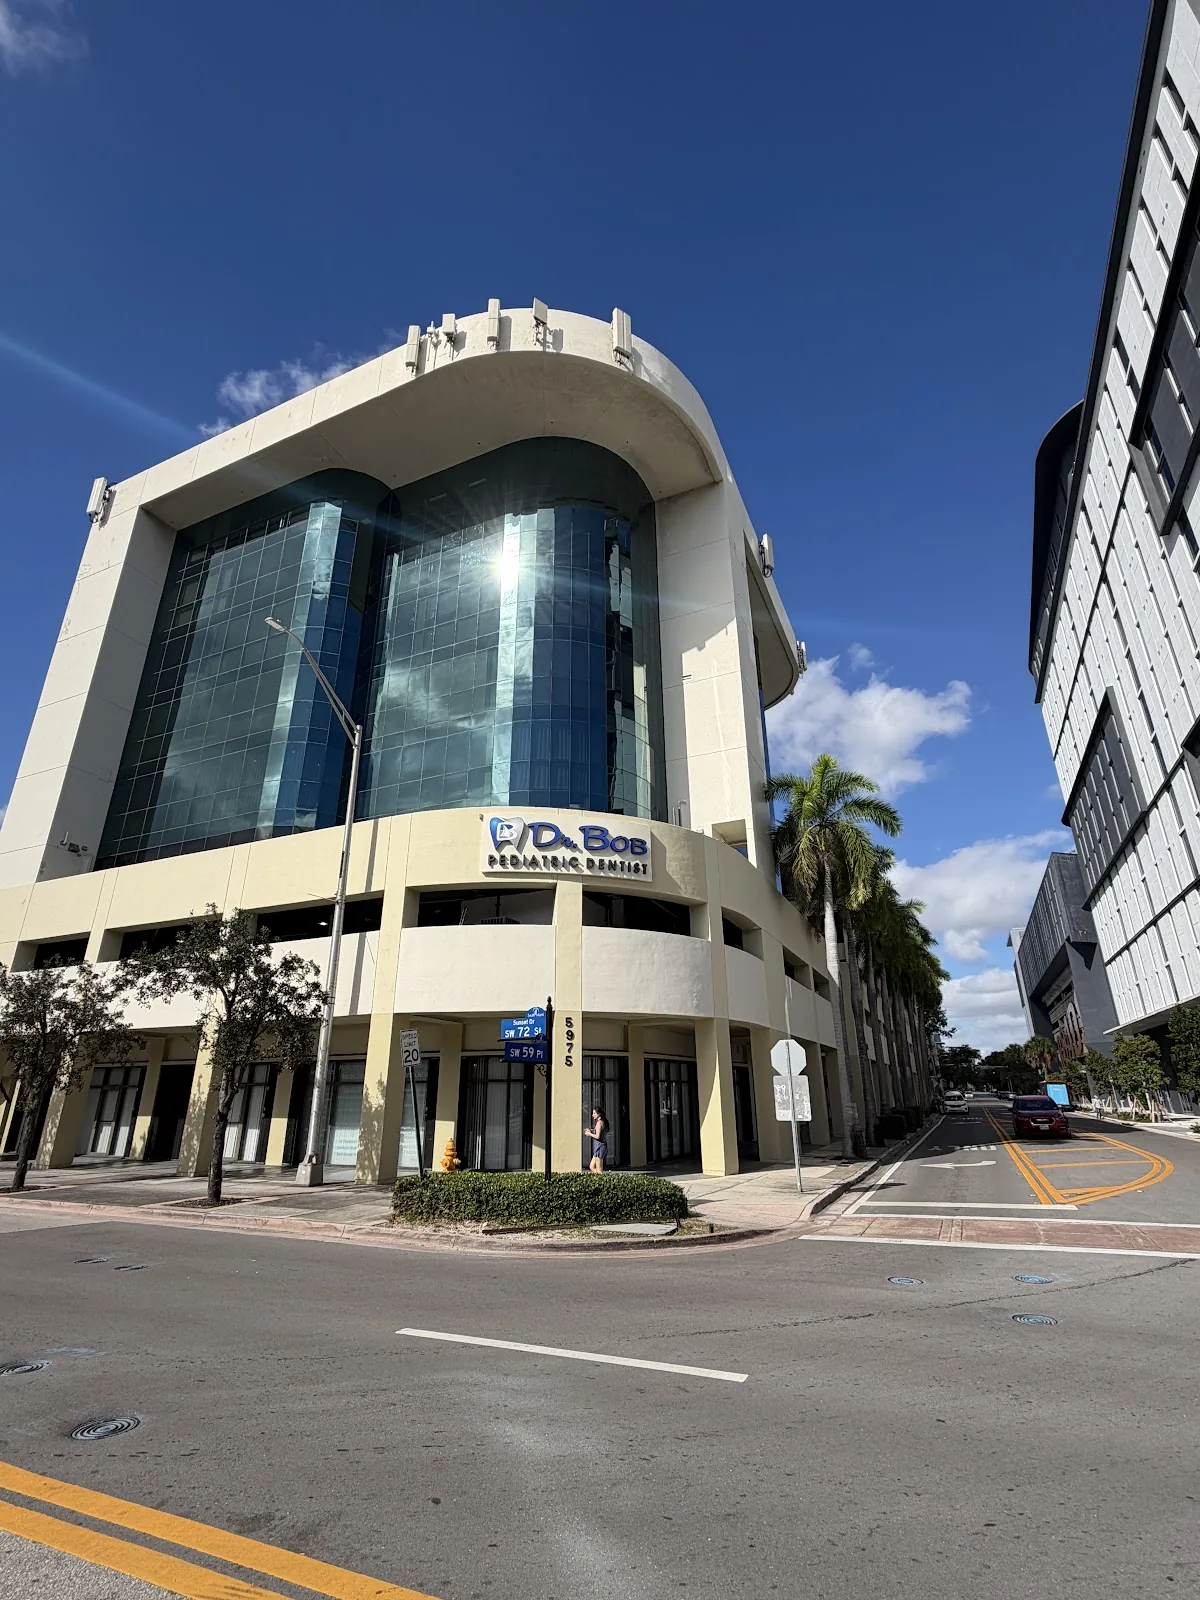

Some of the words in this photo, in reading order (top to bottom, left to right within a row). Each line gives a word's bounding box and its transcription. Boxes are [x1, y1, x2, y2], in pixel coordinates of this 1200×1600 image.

[488, 854, 580, 869] PEDIATRIC
[586, 857, 648, 875] DENTIST
[505, 1029, 515, 1038] SW
[517, 1026, 530, 1037] 72
[565, 1017, 575, 1067] 5975
[404, 1049, 419, 1063] 20
[509, 1048, 520, 1058] SW
[522, 1046, 535, 1058] 59
